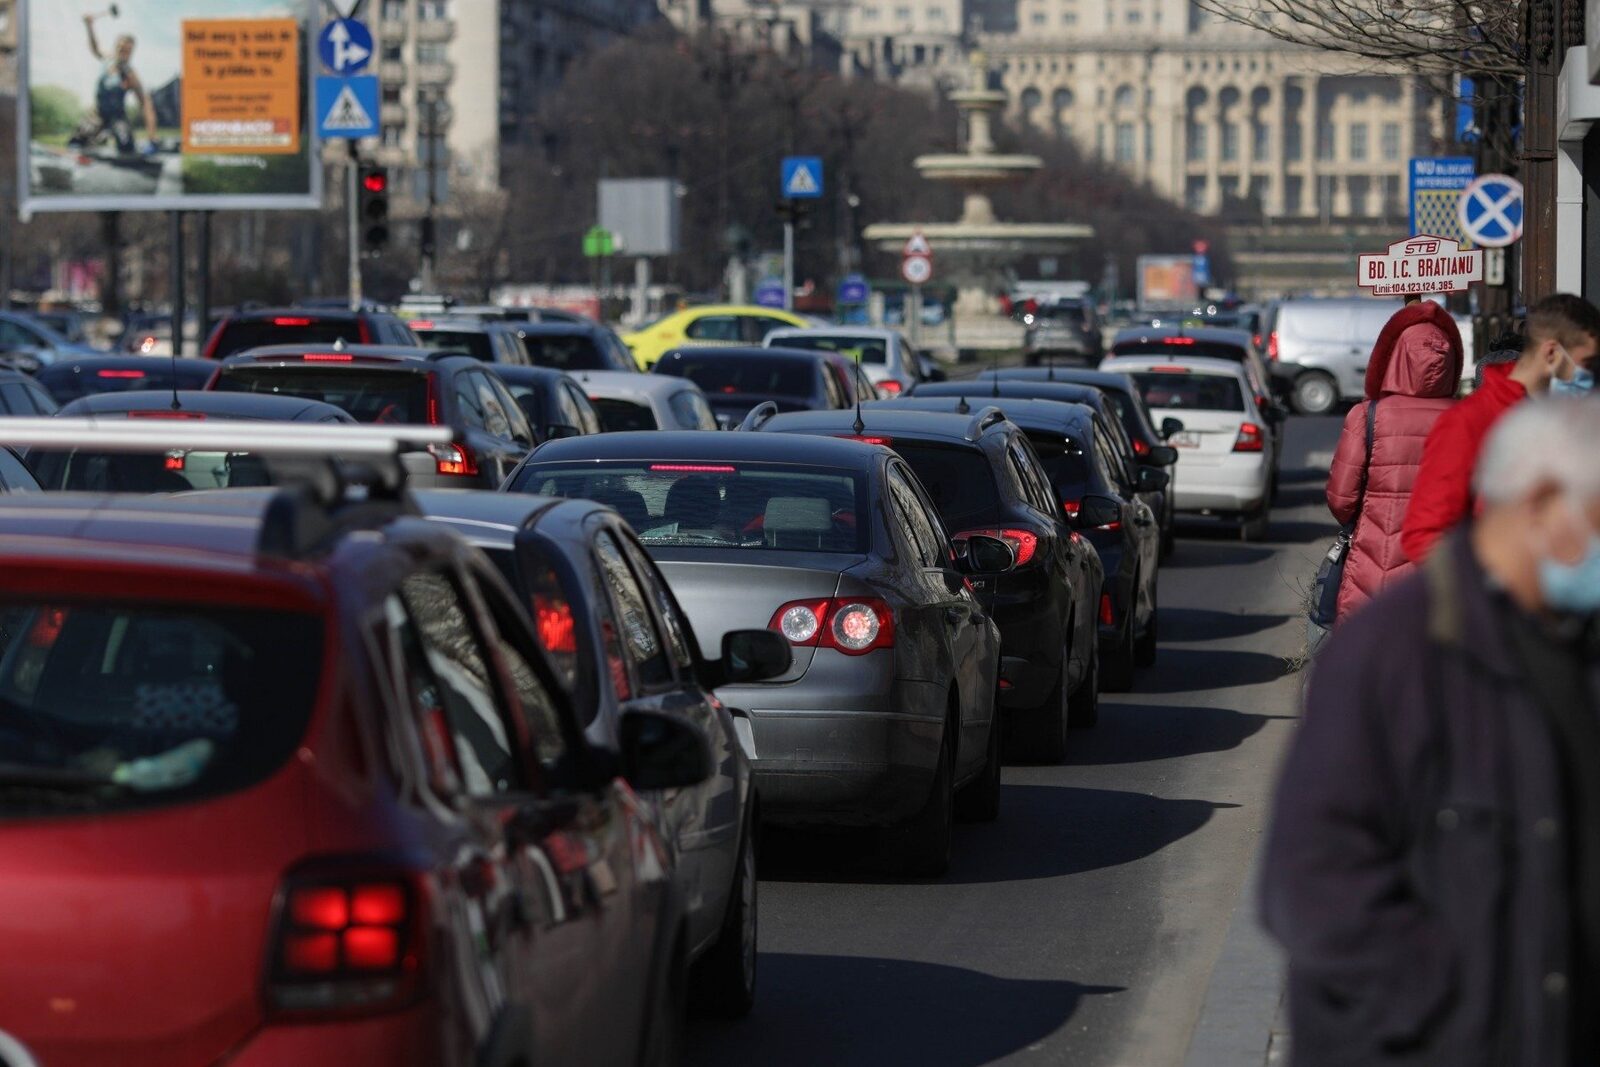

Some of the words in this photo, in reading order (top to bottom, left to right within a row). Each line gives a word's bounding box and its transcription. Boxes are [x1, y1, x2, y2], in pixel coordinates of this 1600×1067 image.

[1415, 160, 1435, 175] NU
[1404, 241, 1438, 255] STB
[1368, 261, 1387, 279] BD.
[1393, 259, 1411, 278] I.C.
[1418, 255, 1473, 277] BRATIANU
